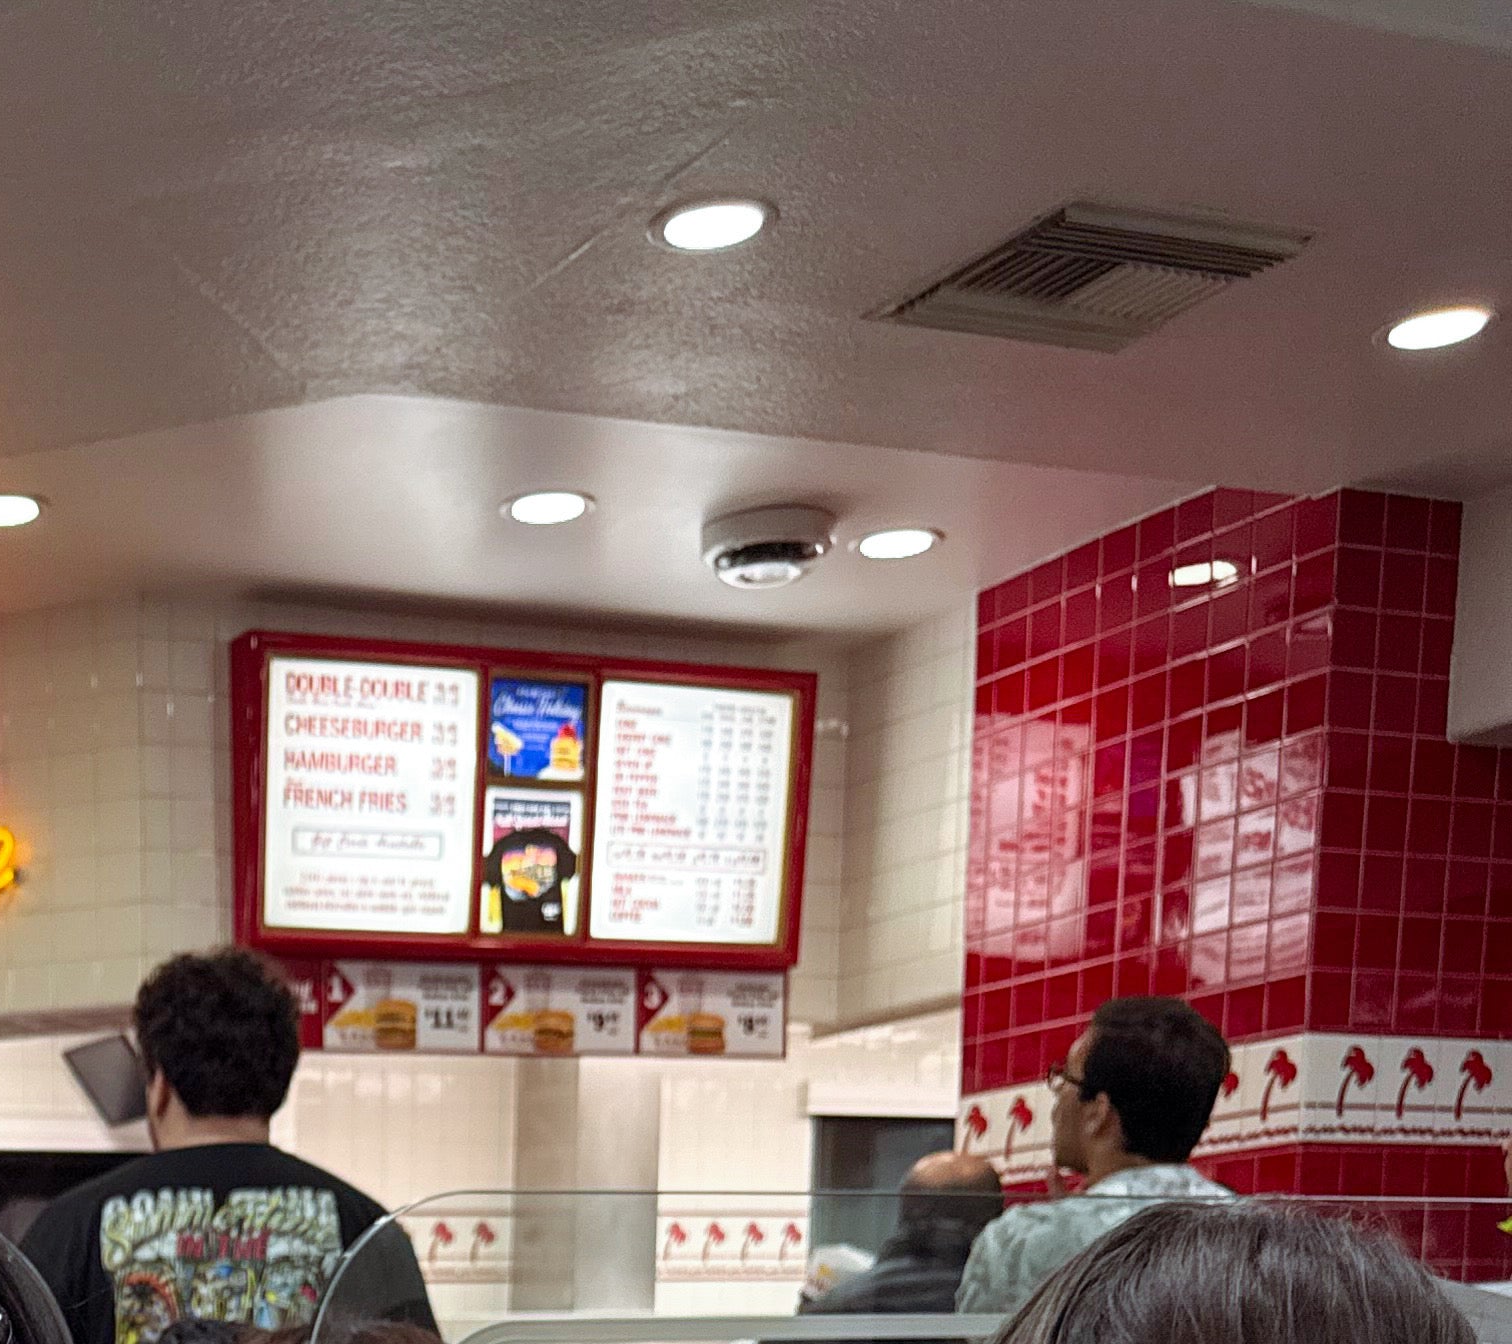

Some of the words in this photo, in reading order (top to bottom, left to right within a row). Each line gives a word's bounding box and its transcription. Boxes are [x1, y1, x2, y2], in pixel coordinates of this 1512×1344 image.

[285, 711, 424, 743] CHEESEBURGER
[284, 746, 398, 776] HAMBURGER
[284, 785, 353, 809] FRENCH
[359, 790, 407, 814] FRIES
